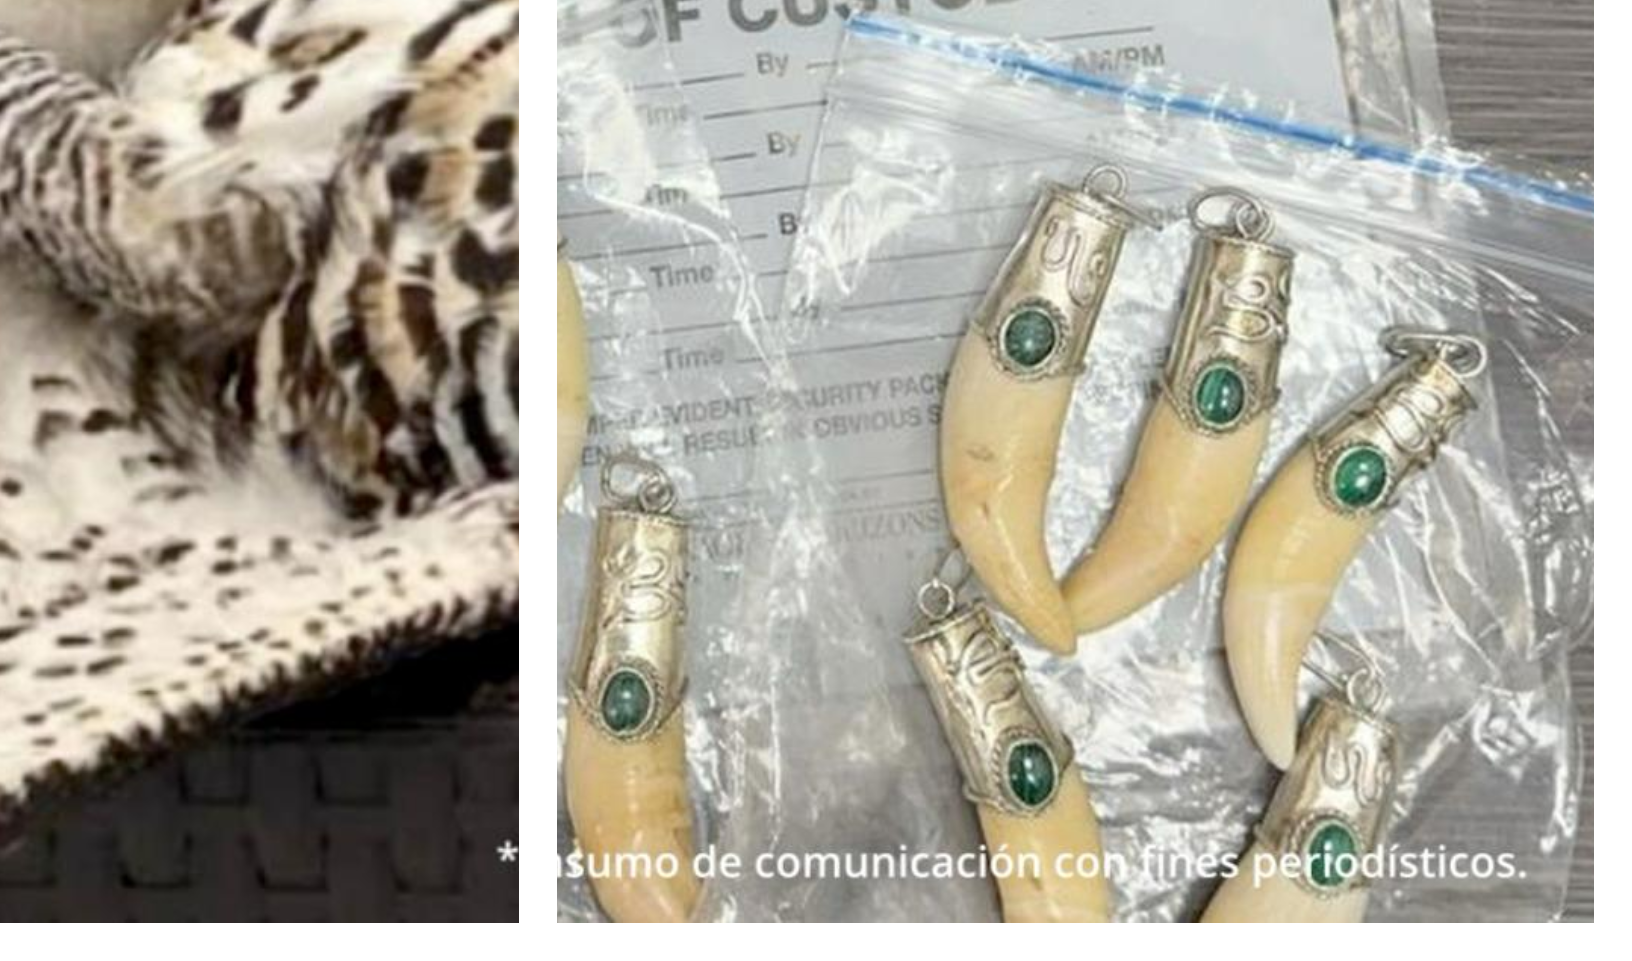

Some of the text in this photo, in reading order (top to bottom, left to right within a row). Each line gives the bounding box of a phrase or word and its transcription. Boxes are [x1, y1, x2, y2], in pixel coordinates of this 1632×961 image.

[756, 51, 790, 76] By
[767, 131, 801, 157] By
[778, 212, 802, 237] B
[649, 264, 716, 289] Time
[814, 405, 921, 439] OBVIOUS
